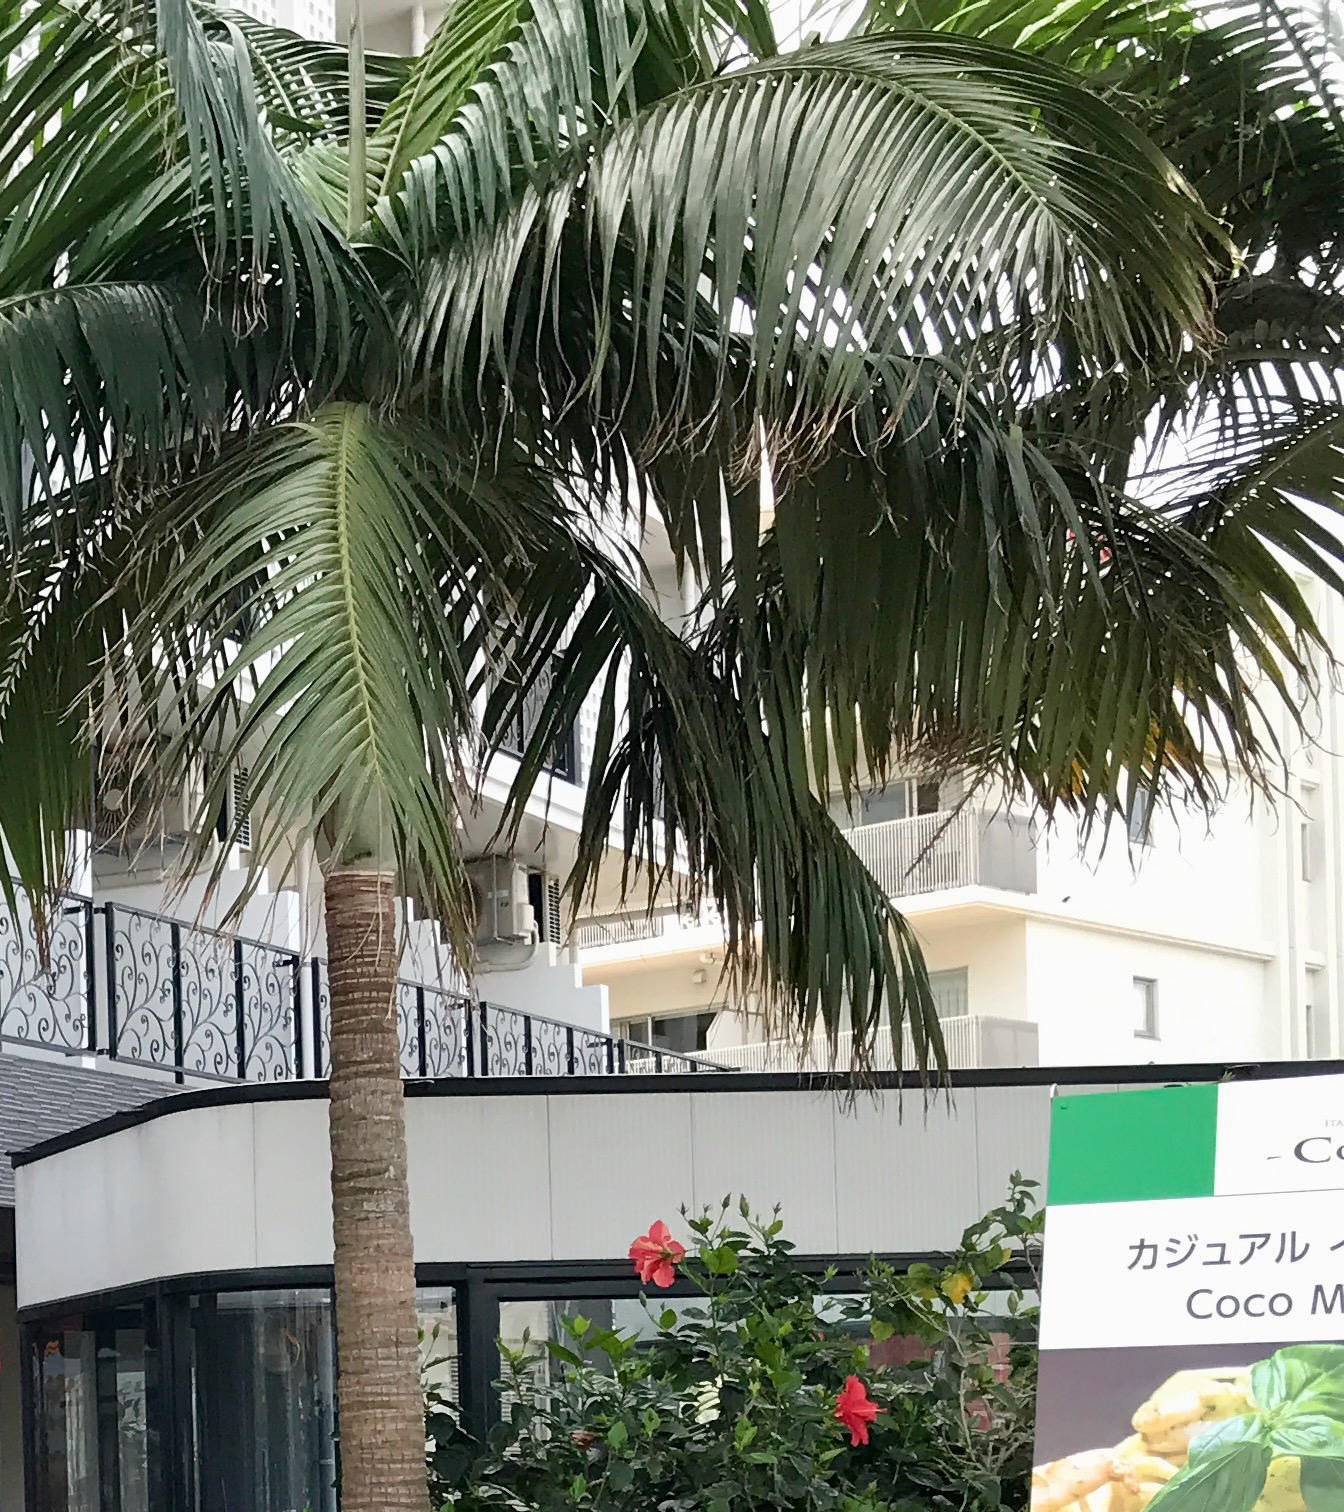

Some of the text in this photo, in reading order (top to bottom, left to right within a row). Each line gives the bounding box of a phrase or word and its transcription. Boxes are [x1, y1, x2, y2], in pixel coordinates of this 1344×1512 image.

[1127, 1231, 1310, 1270] カジュアル
[1186, 1284, 1344, 1319] Coco M
